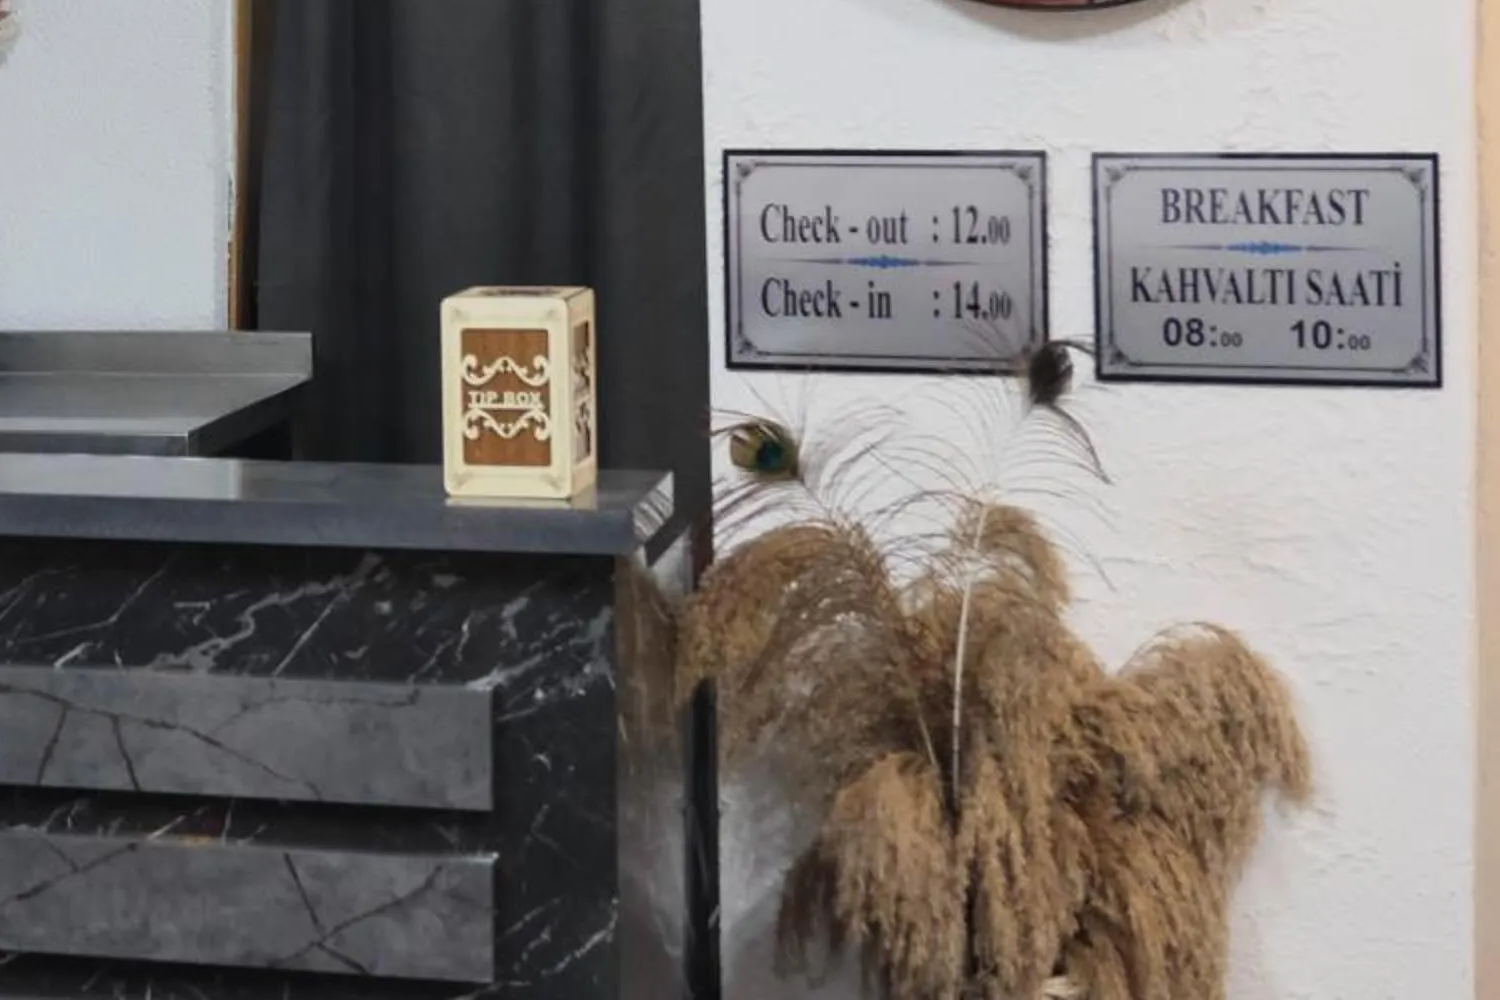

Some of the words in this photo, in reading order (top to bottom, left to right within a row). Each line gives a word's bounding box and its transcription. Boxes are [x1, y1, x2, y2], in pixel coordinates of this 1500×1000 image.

[1161, 187, 1370, 225] BREAKFAST
[1130, 266, 1296, 305] KAHVALTI
[1306, 261, 1403, 307] SAATİ
[1163, 317, 1244, 348] 08:00
[1289, 319, 1371, 350] 10:00
[467, 391, 499, 406] TIP
